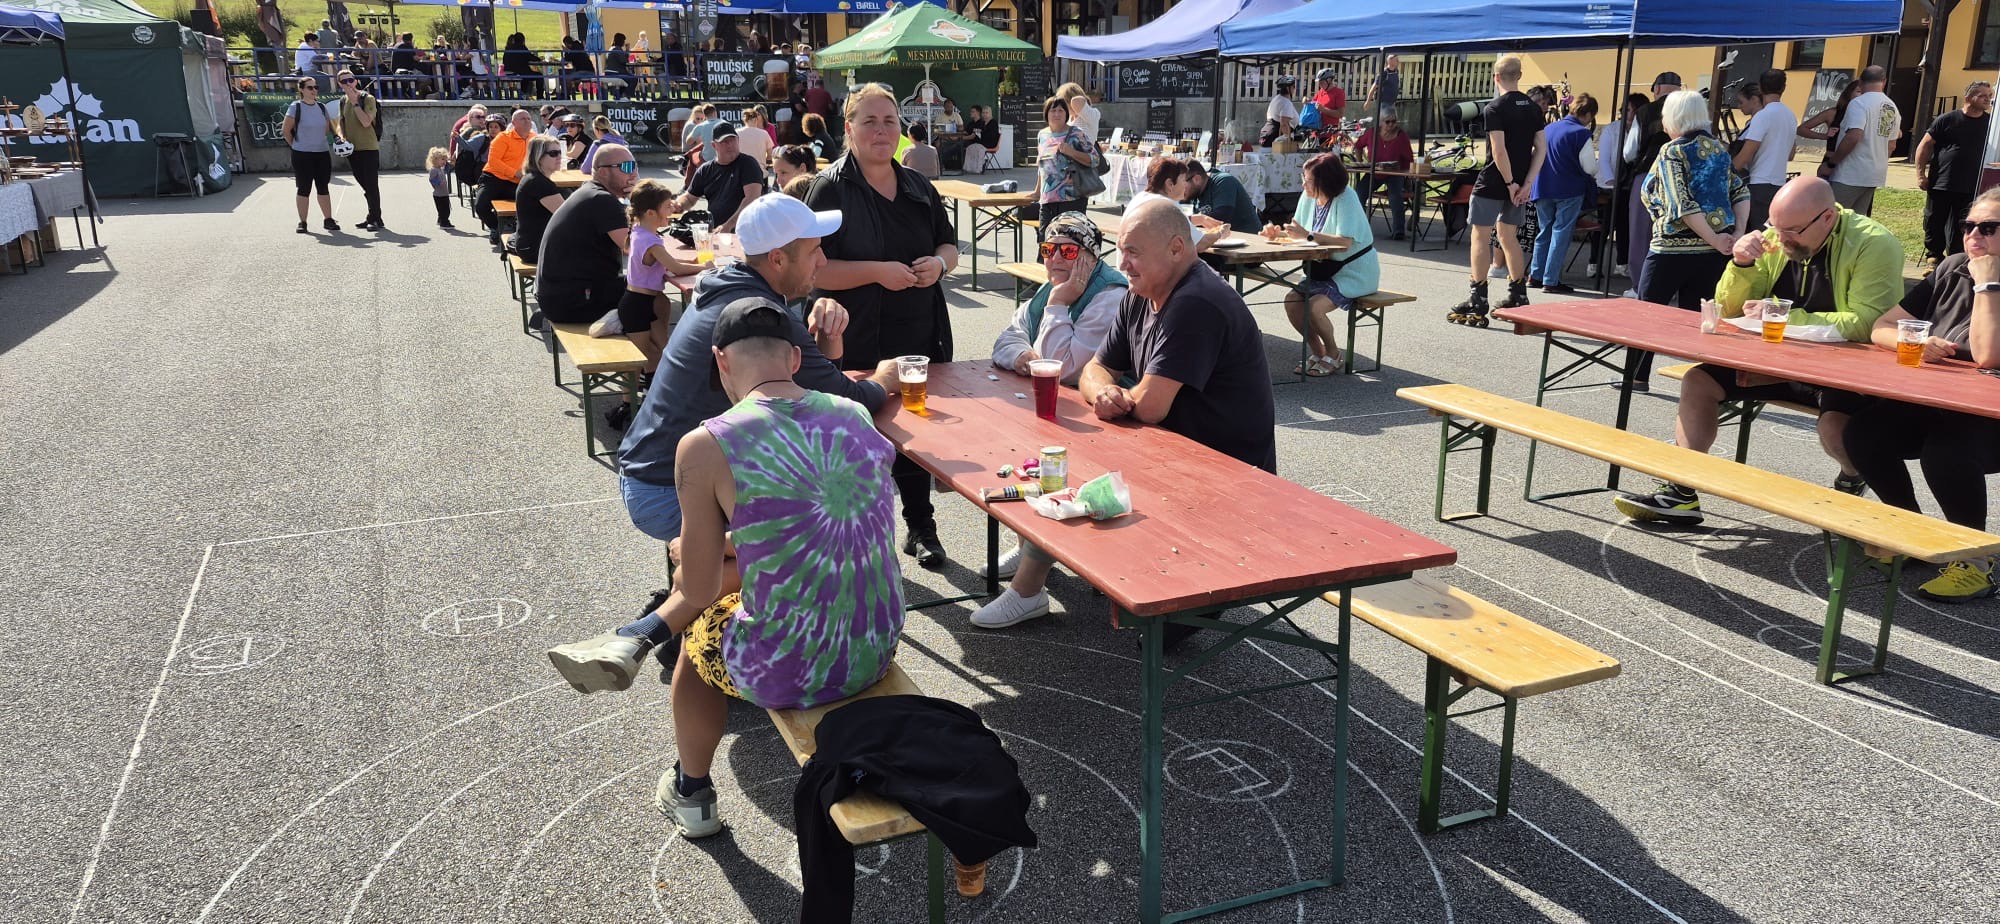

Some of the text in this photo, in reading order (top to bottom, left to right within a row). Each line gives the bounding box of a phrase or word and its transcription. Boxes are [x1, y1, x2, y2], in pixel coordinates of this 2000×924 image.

[957, 49, 990, 60] PIVOVAR
[707, 59, 754, 72] POLIČSKÉ
[708, 73, 730, 85] PIVO
[608, 107, 657, 121] POLIČSKÉ
